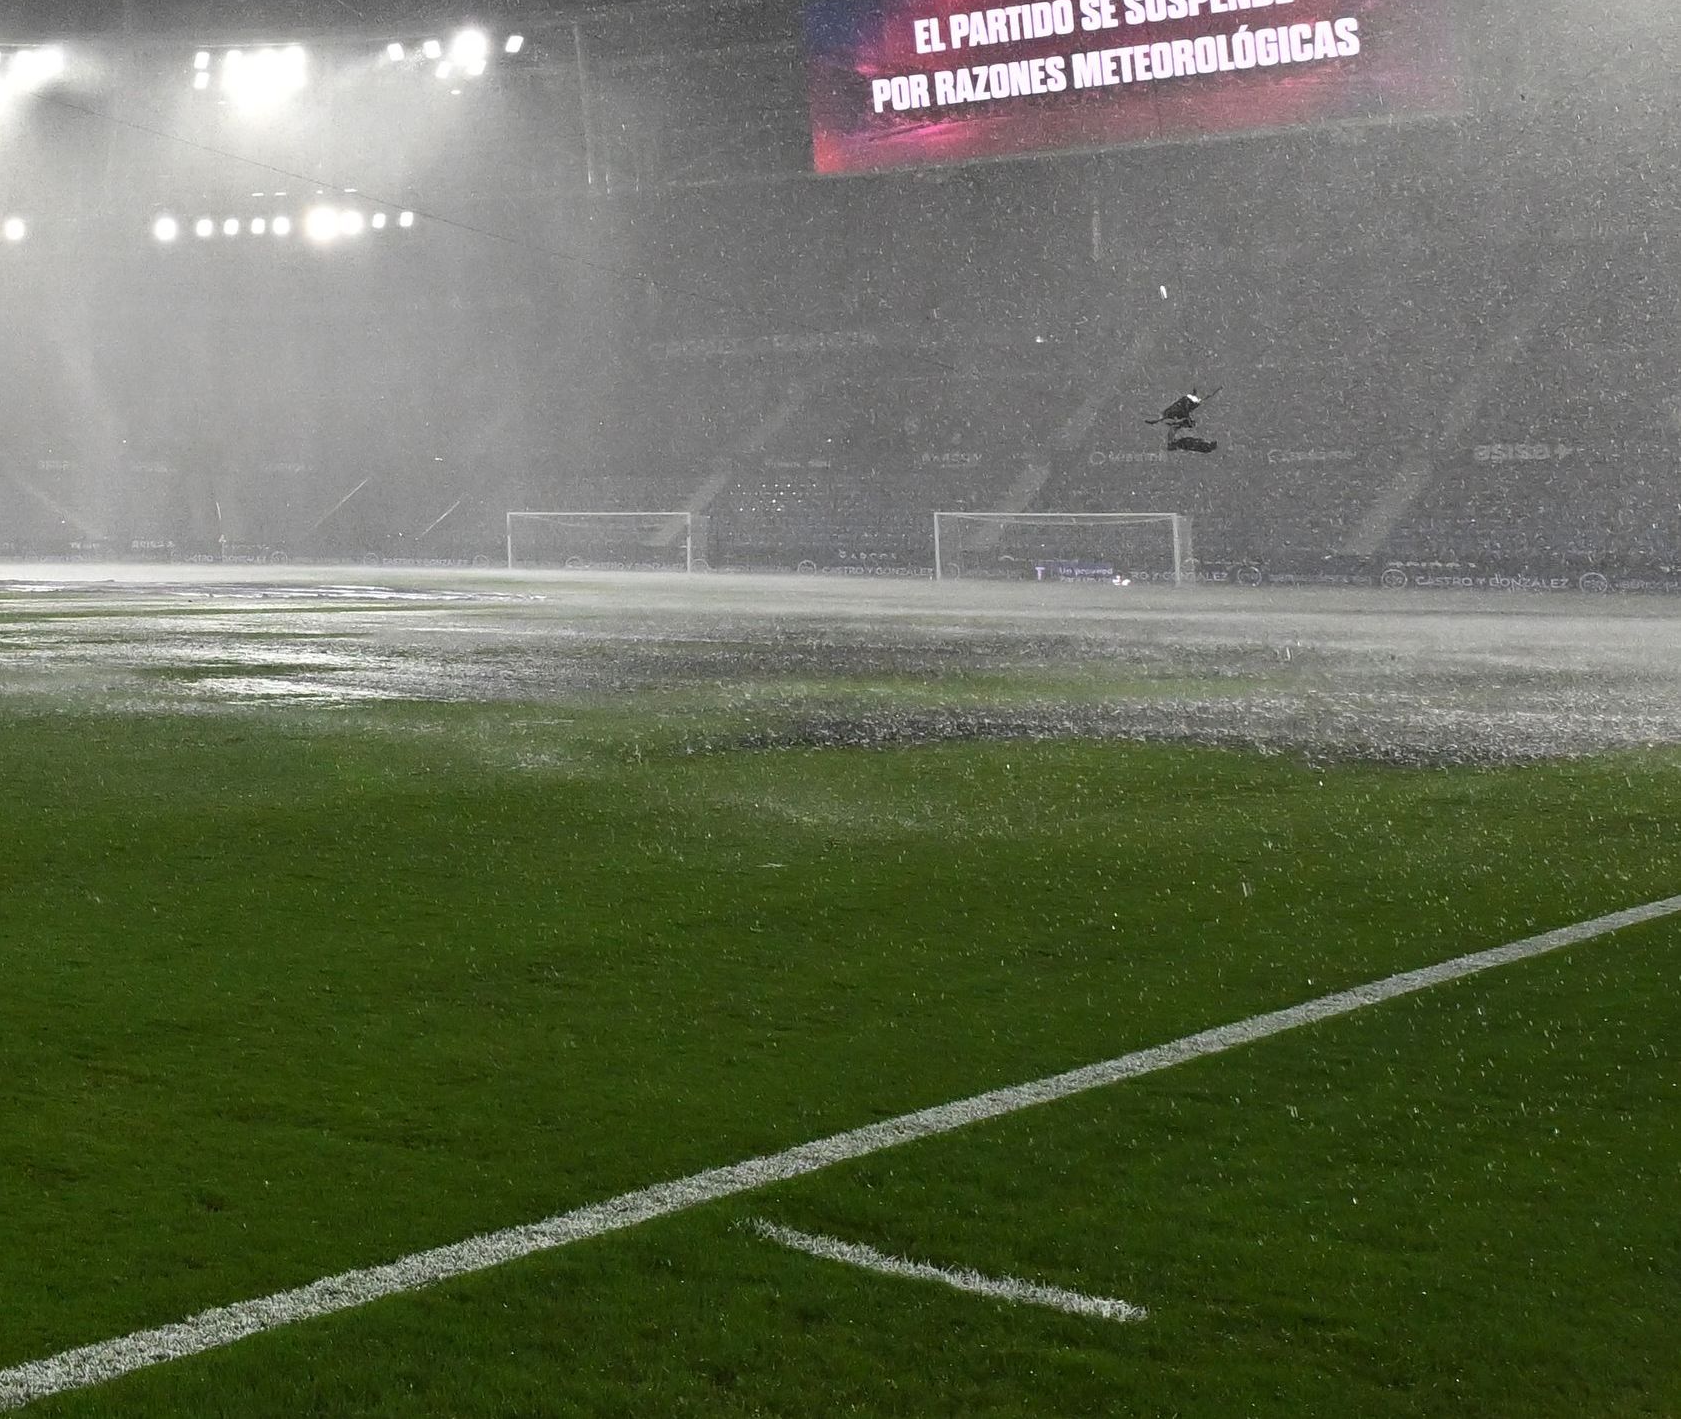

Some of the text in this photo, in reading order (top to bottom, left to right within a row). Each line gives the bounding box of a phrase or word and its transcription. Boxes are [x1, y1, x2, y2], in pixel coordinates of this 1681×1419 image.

[872, 17, 1360, 113] POR RAZONES METEOROLÓGICAS
[914, 19, 945, 54] EL
